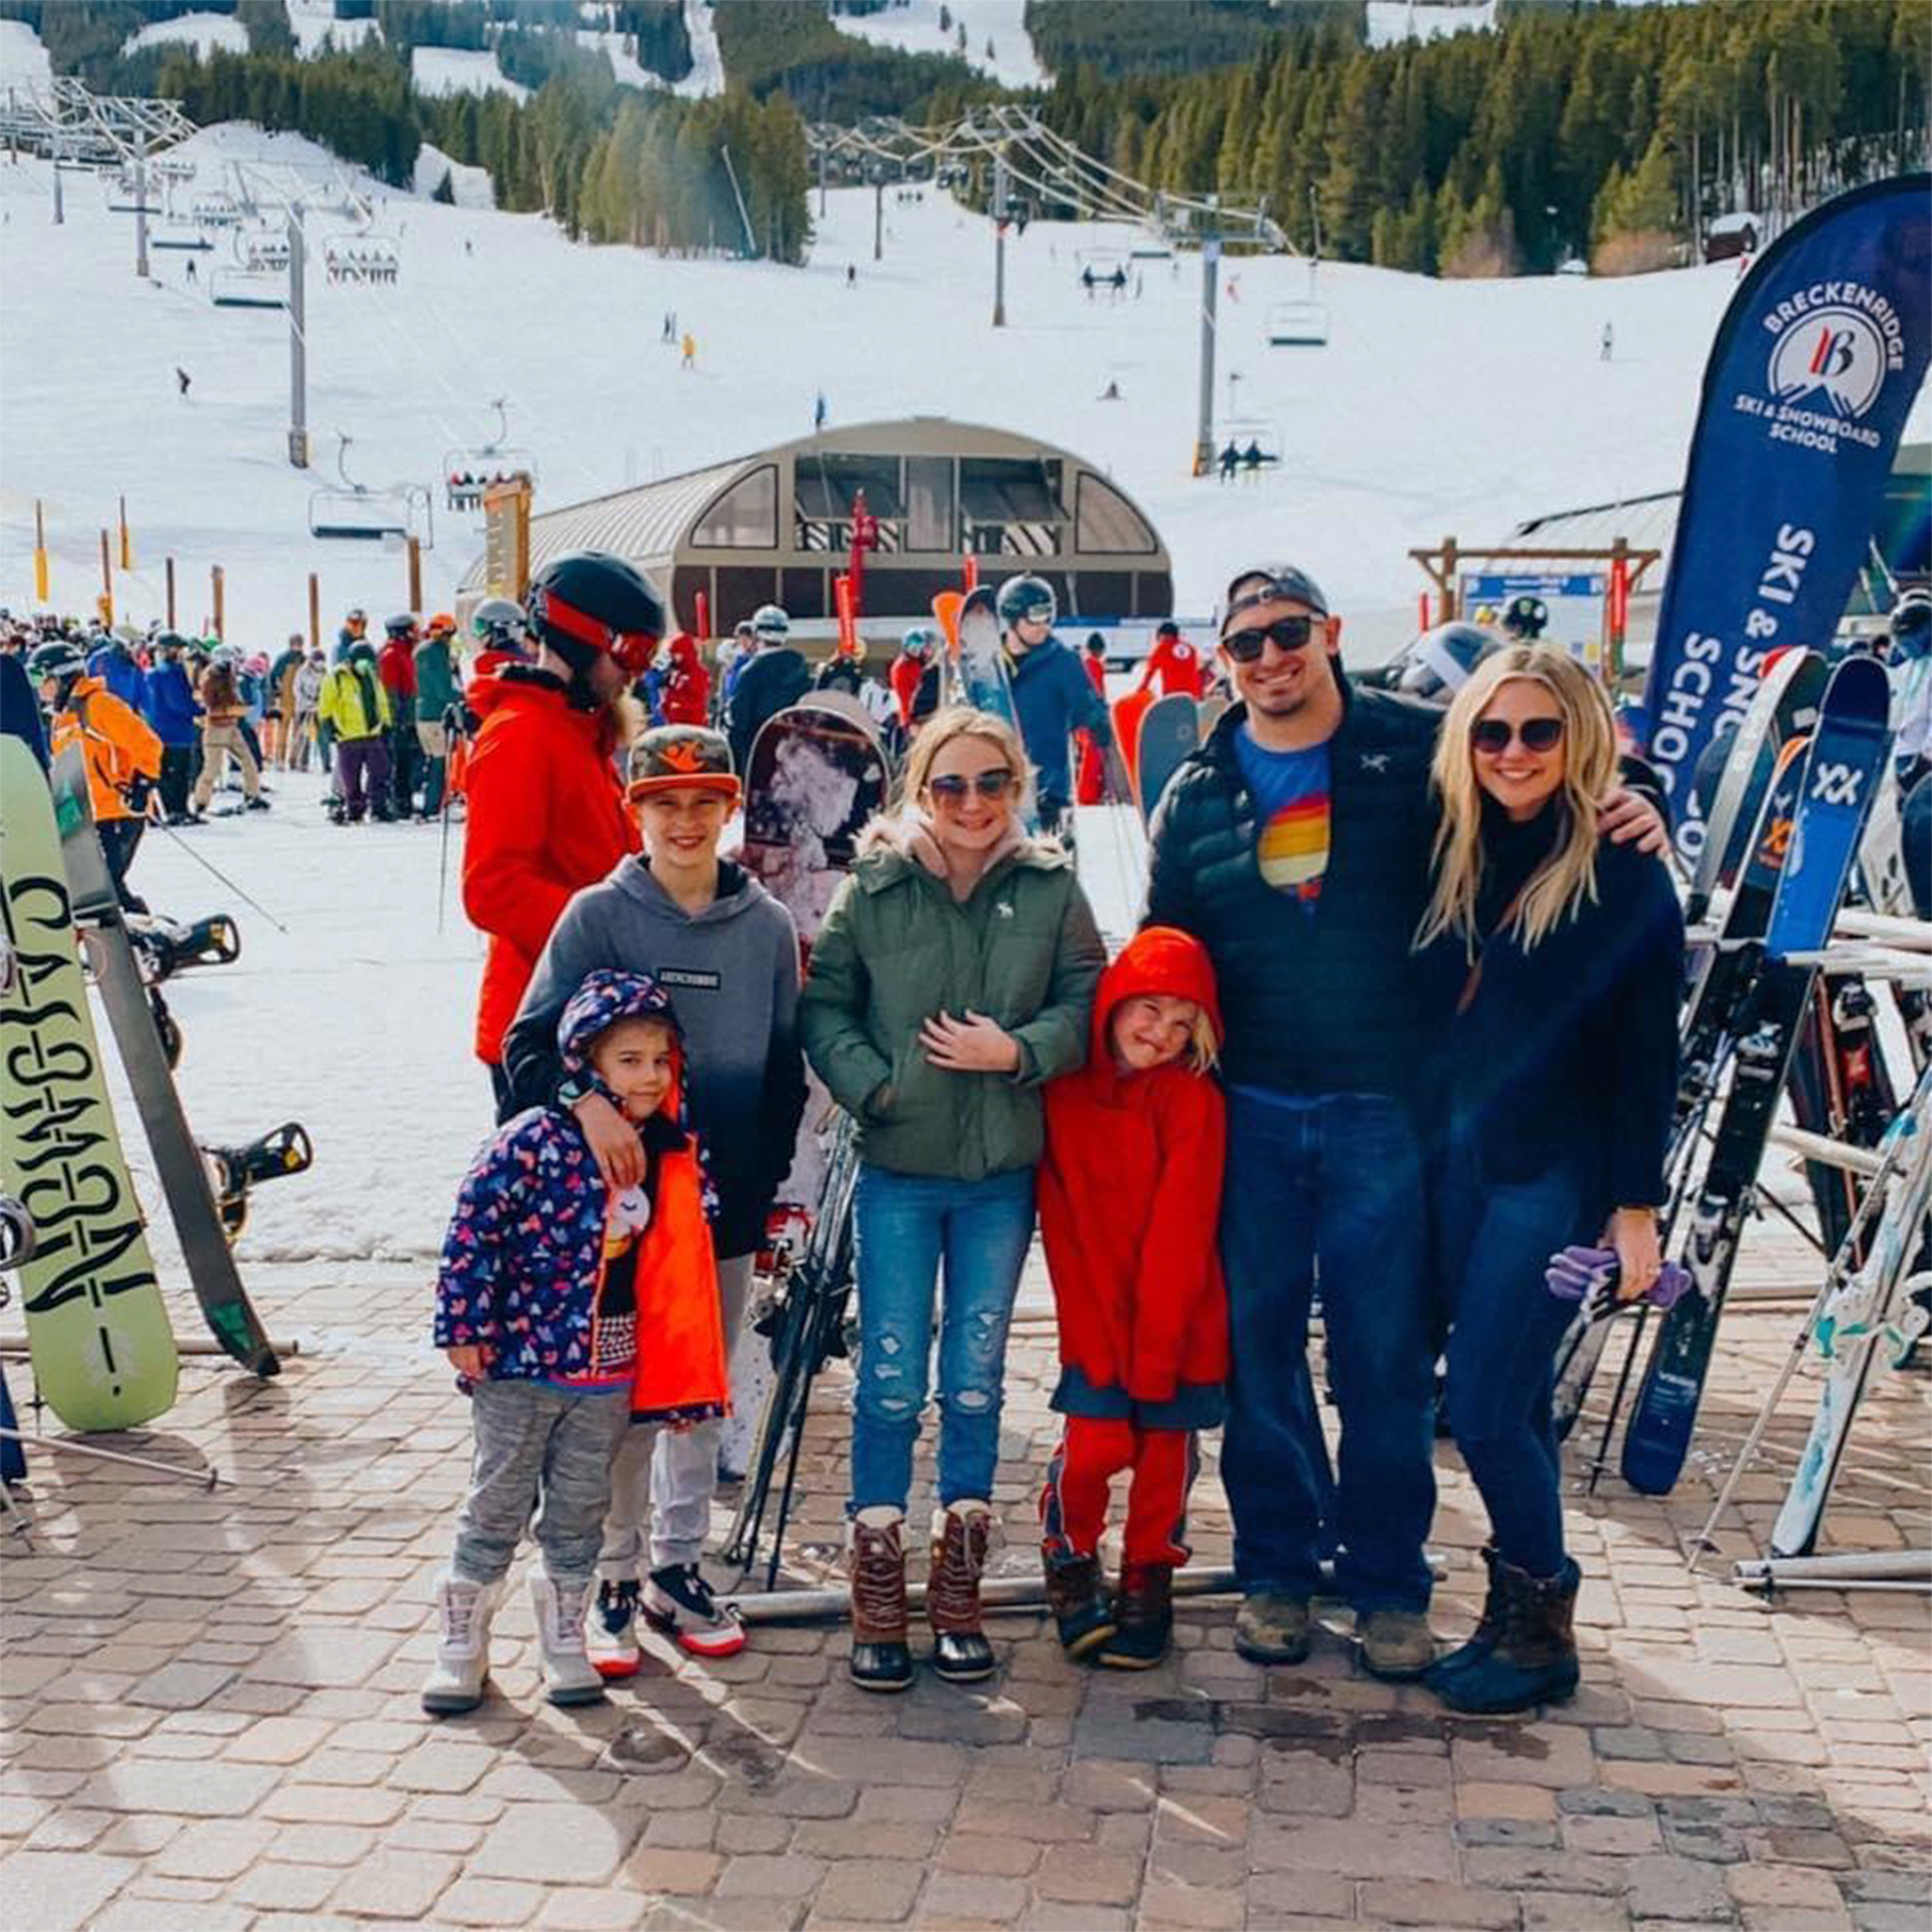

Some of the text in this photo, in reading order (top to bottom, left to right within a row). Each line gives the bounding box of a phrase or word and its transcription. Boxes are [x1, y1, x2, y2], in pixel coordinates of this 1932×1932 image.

[1763, 281, 1905, 372] BRECKENRIDGE
[1733, 394, 1764, 414] SKI
[1776, 406, 1881, 448] SNOWBOARD
[1769, 422, 1838, 454] SCHOOL
[1758, 524, 1815, 605] SKI
[1744, 608, 1778, 639] &
[1651, 633, 1722, 795] SCHO
